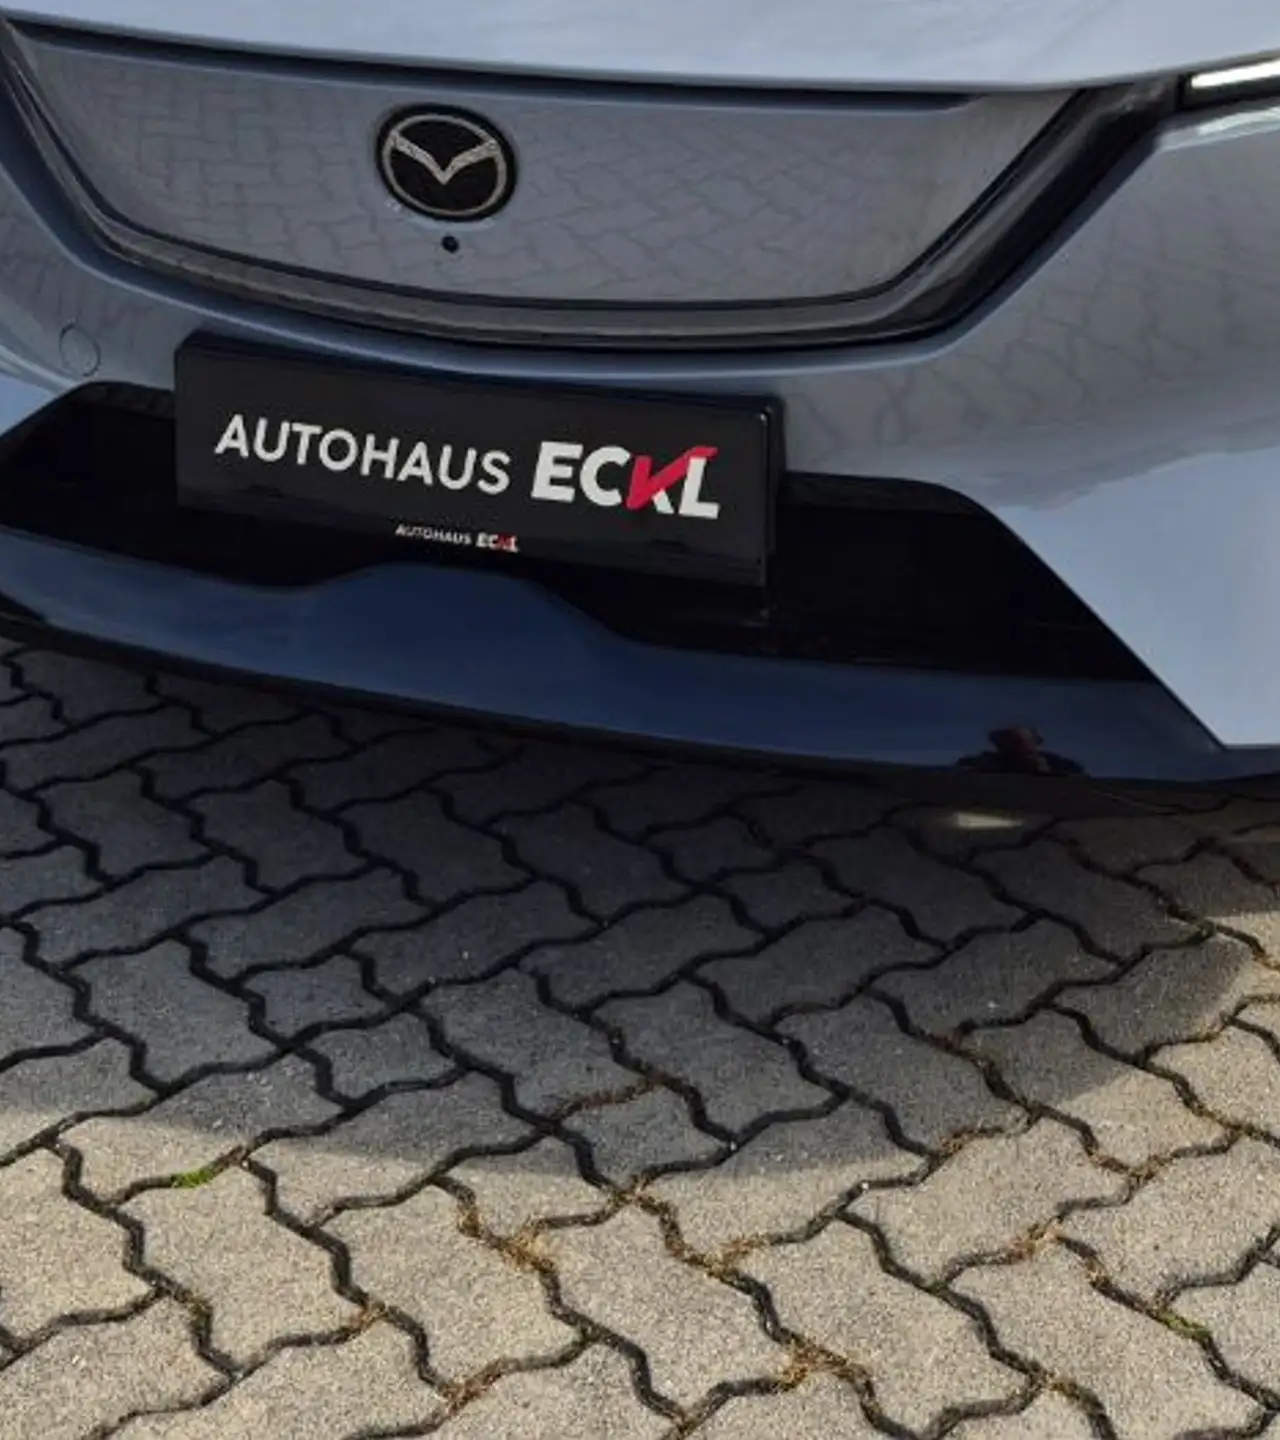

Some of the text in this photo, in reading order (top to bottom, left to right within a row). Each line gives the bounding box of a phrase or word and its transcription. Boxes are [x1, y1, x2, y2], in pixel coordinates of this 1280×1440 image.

[215, 414, 719, 519] AUTOHAUS ECKL
[395, 524, 471, 545] AUTOHAUS
